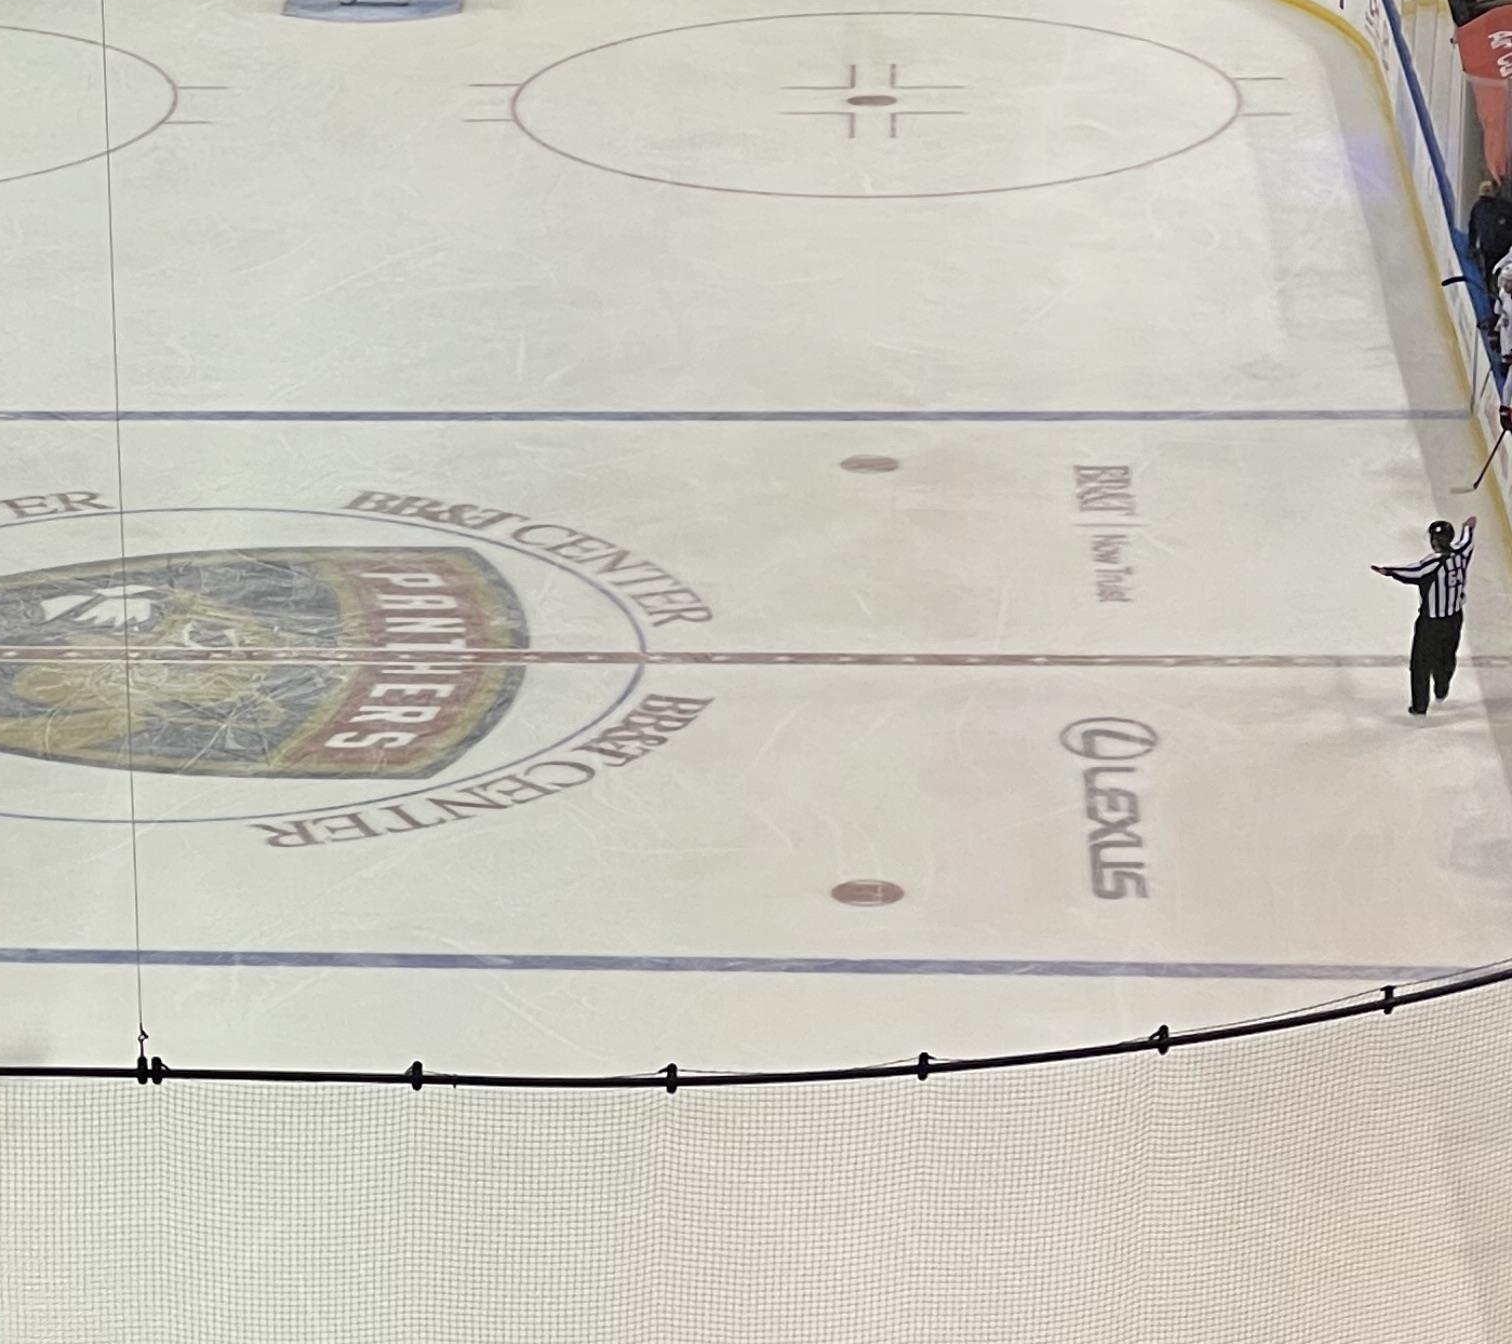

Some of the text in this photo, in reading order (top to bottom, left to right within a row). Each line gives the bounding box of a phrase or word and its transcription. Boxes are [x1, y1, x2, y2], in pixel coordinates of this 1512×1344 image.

[340, 490, 714, 628] BB&T CENTER
[325, 571, 470, 750] PANTHERS
[249, 693, 715, 848] BB&T CENTER
[1082, 766, 1149, 900] LEXUS
